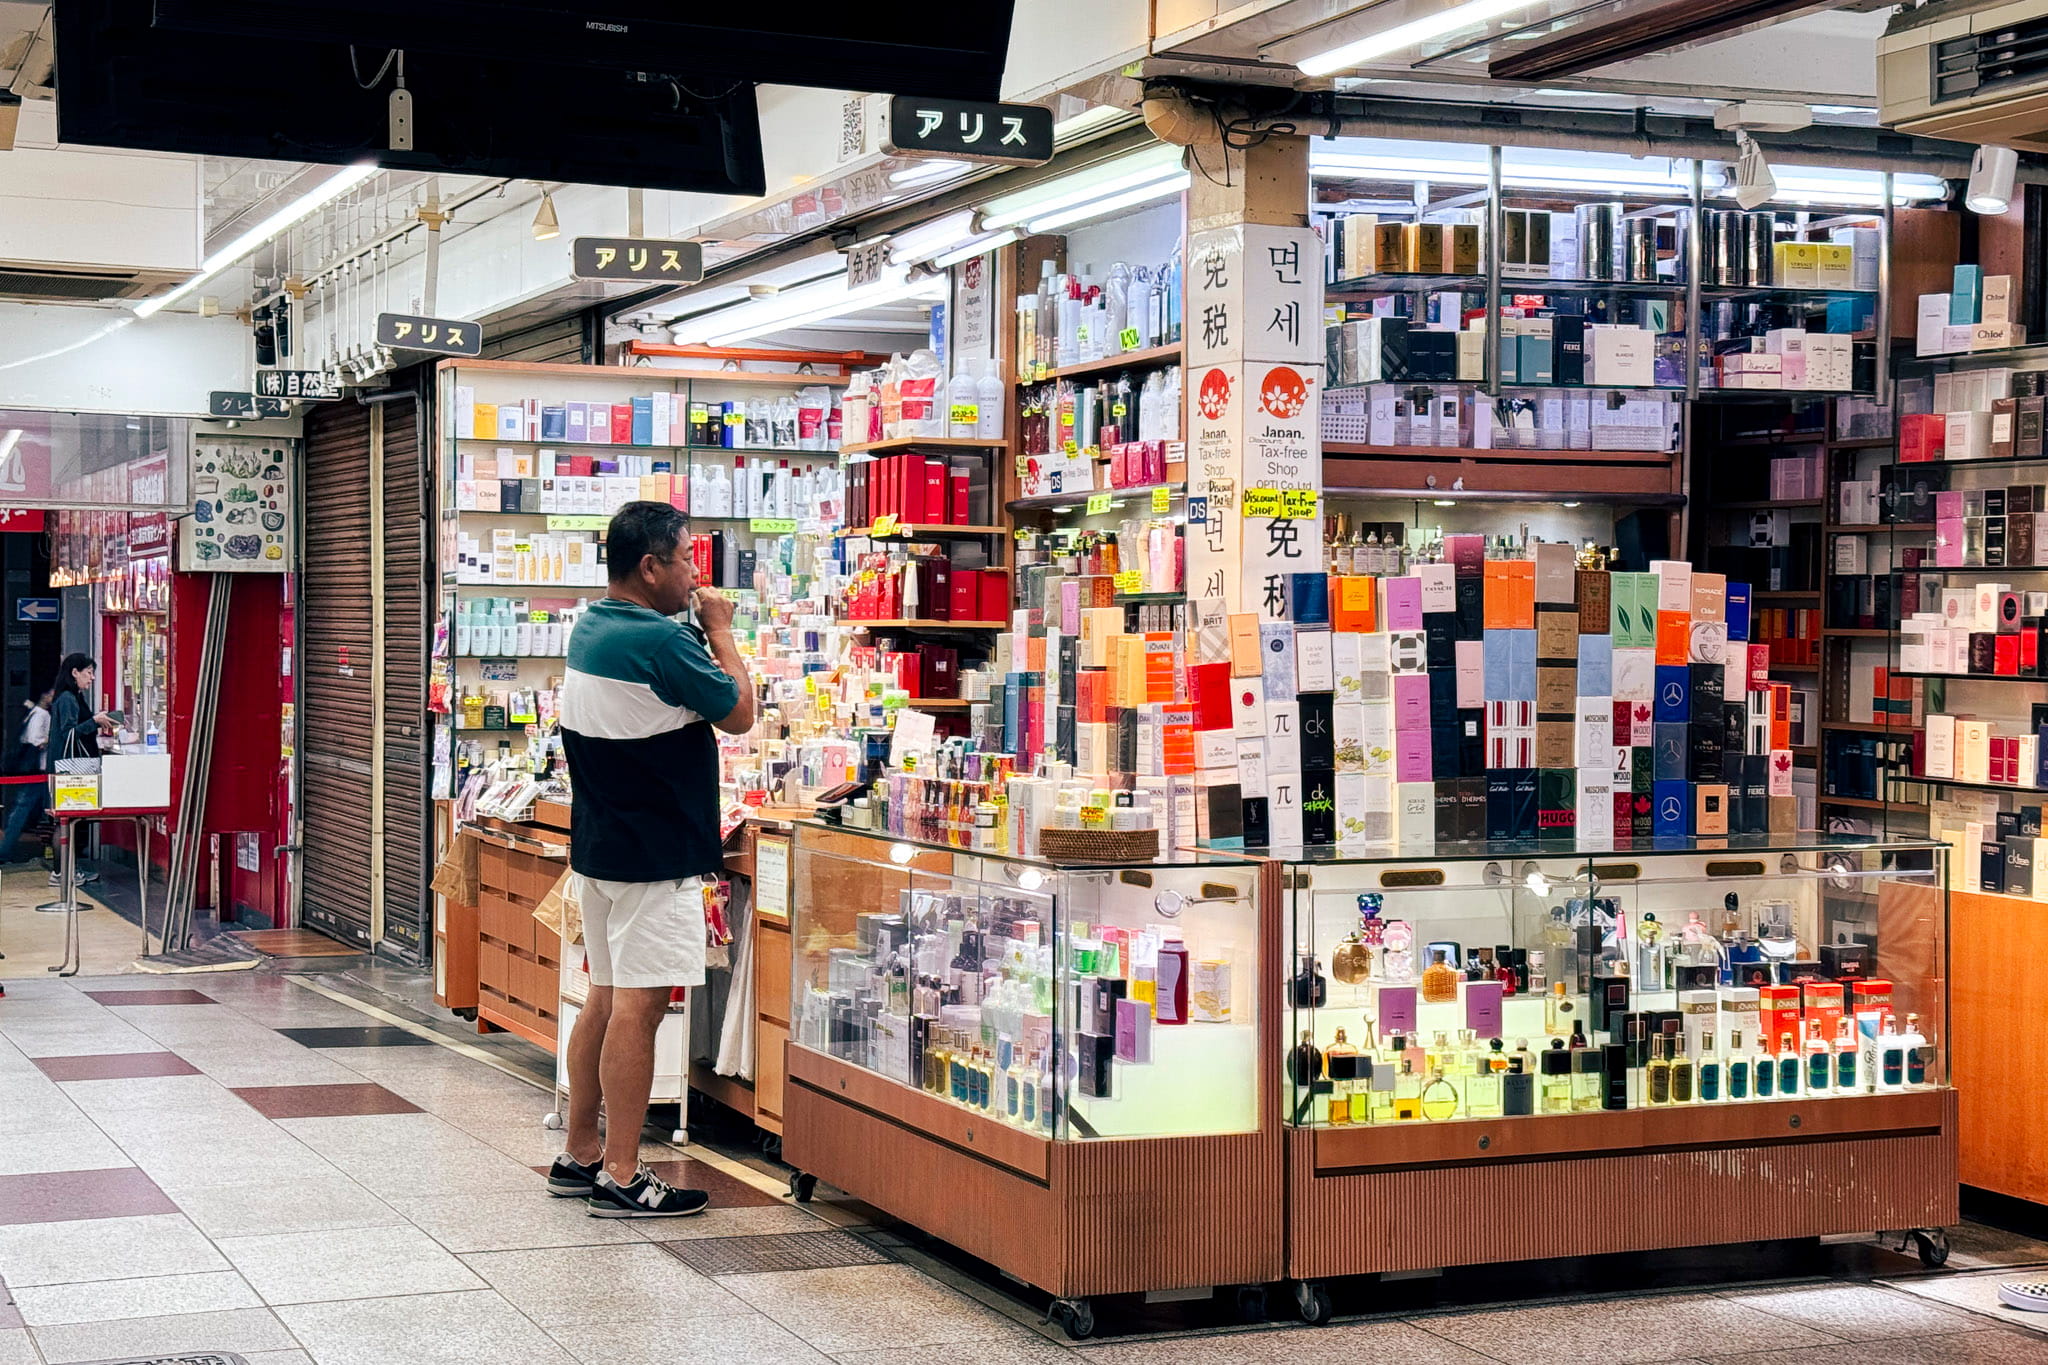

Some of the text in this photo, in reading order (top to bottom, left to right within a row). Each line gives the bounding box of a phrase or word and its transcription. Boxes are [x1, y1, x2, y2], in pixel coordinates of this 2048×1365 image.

[585, 21, 628, 33] MITSUBISHI
[915, 109, 1028, 147] アリス
[594, 247, 683, 272] アリス
[852, 245, 879, 287] 免税
[1266, 241, 1303, 348] 면세
[394, 321, 465, 347] アリス
[1977, 329, 2004, 339] Chloé
[1563, 343, 1581, 351] FIERCE
[1375, 408, 1390, 421] ck
[1199, 447, 1232, 460] Tax-free
[1259, 444, 1308, 459] Tax-free
[1204, 464, 1226, 477] Shop
[1267, 462, 1299, 478] Shop
[1051, 475, 1062, 490] DS
[479, 490, 498, 499] Chloé
[1189, 502, 1206, 520] DS
[1248, 506, 1275, 516] SHOP
[1287, 507, 1313, 517] SHOP
[1204, 510, 1225, 599] 면세
[1203, 617, 1223, 626] BRIT
[1174, 642, 1185, 693] MUSK
[1751, 670, 1768, 680] WOOD
[1305, 709, 1327, 735] ck
[1584, 714, 1609, 723] MOSCHINO
[1633, 725, 1650, 735] WOOD
[1618, 749, 1626, 770] 2
[1613, 771, 1631, 781] WOOD
[1311, 783, 1326, 800] ck
[1585, 786, 1609, 794] MOSCHINO
[1747, 788, 1766, 796] FIERCE
[1303, 799, 1335, 815] SHOCK
[1540, 811, 1575, 824] HUGO
